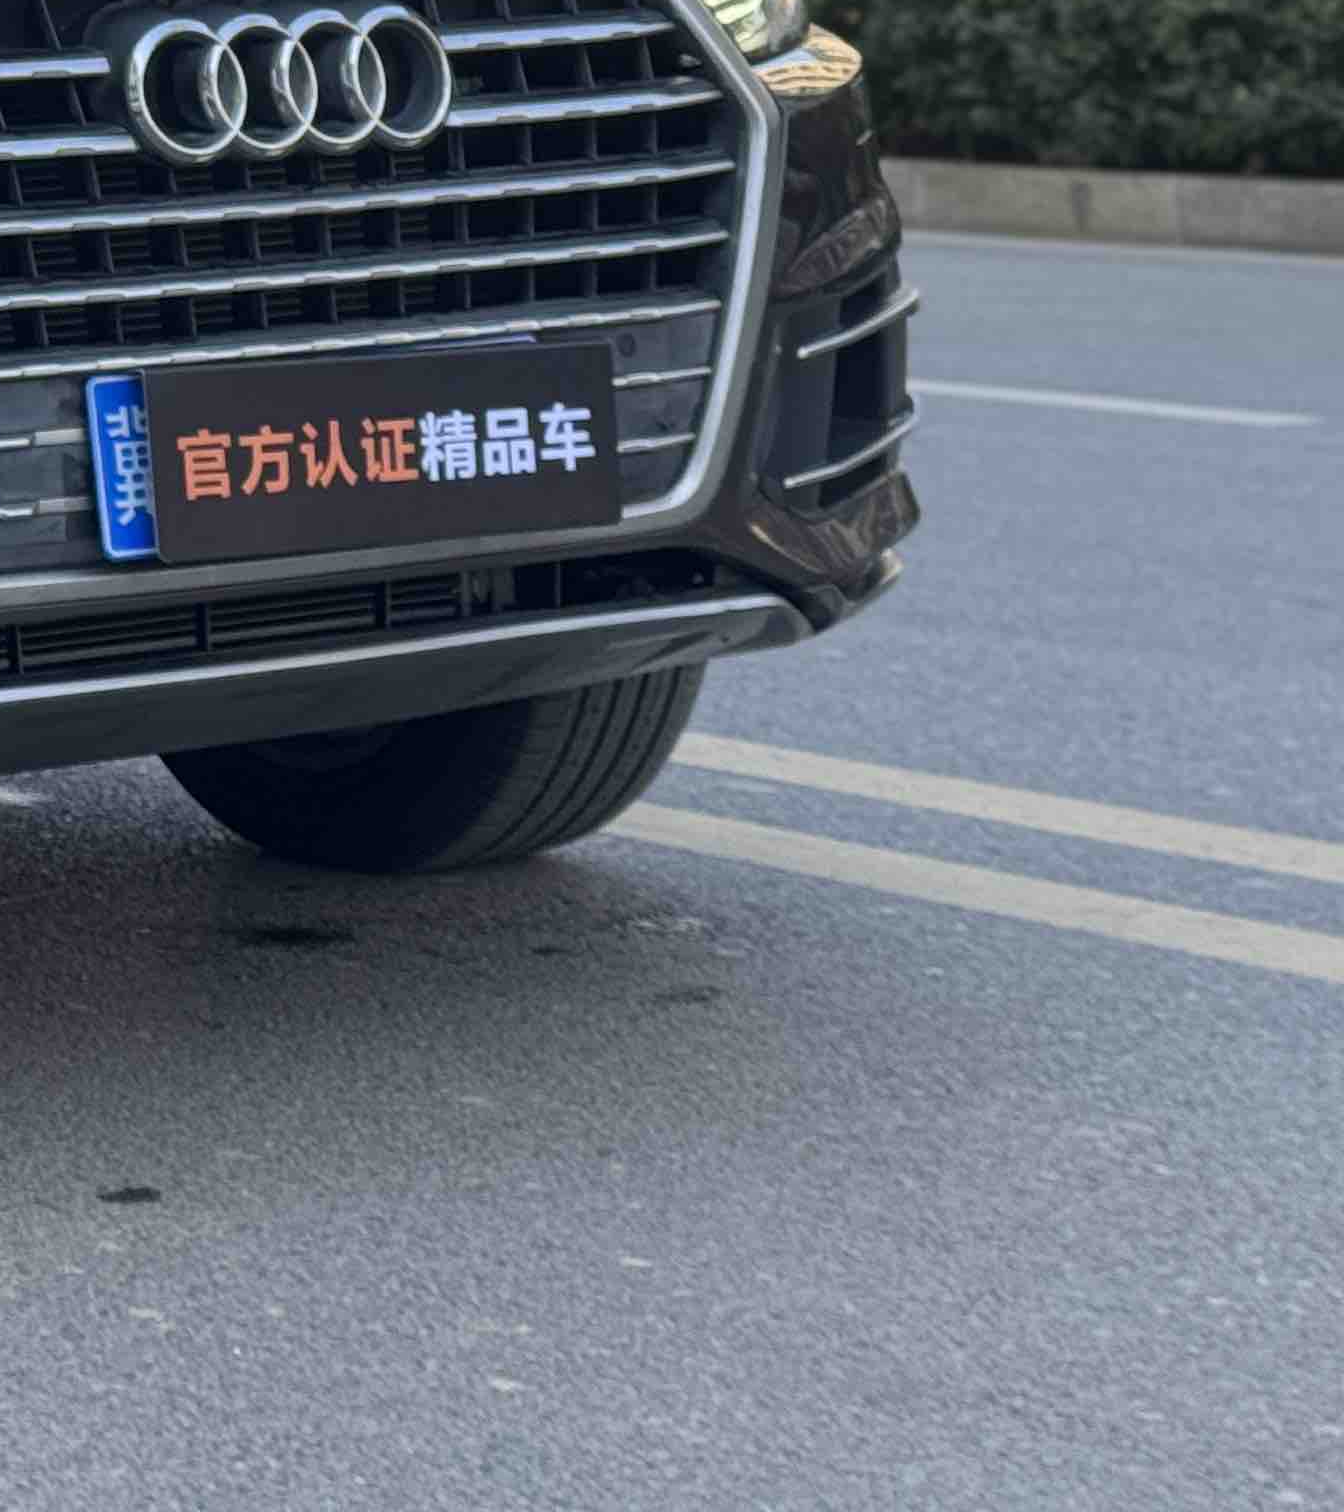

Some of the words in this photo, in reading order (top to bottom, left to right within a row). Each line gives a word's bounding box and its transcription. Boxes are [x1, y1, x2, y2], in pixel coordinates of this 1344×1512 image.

[176, 401, 597, 502] 官方认证精品车
